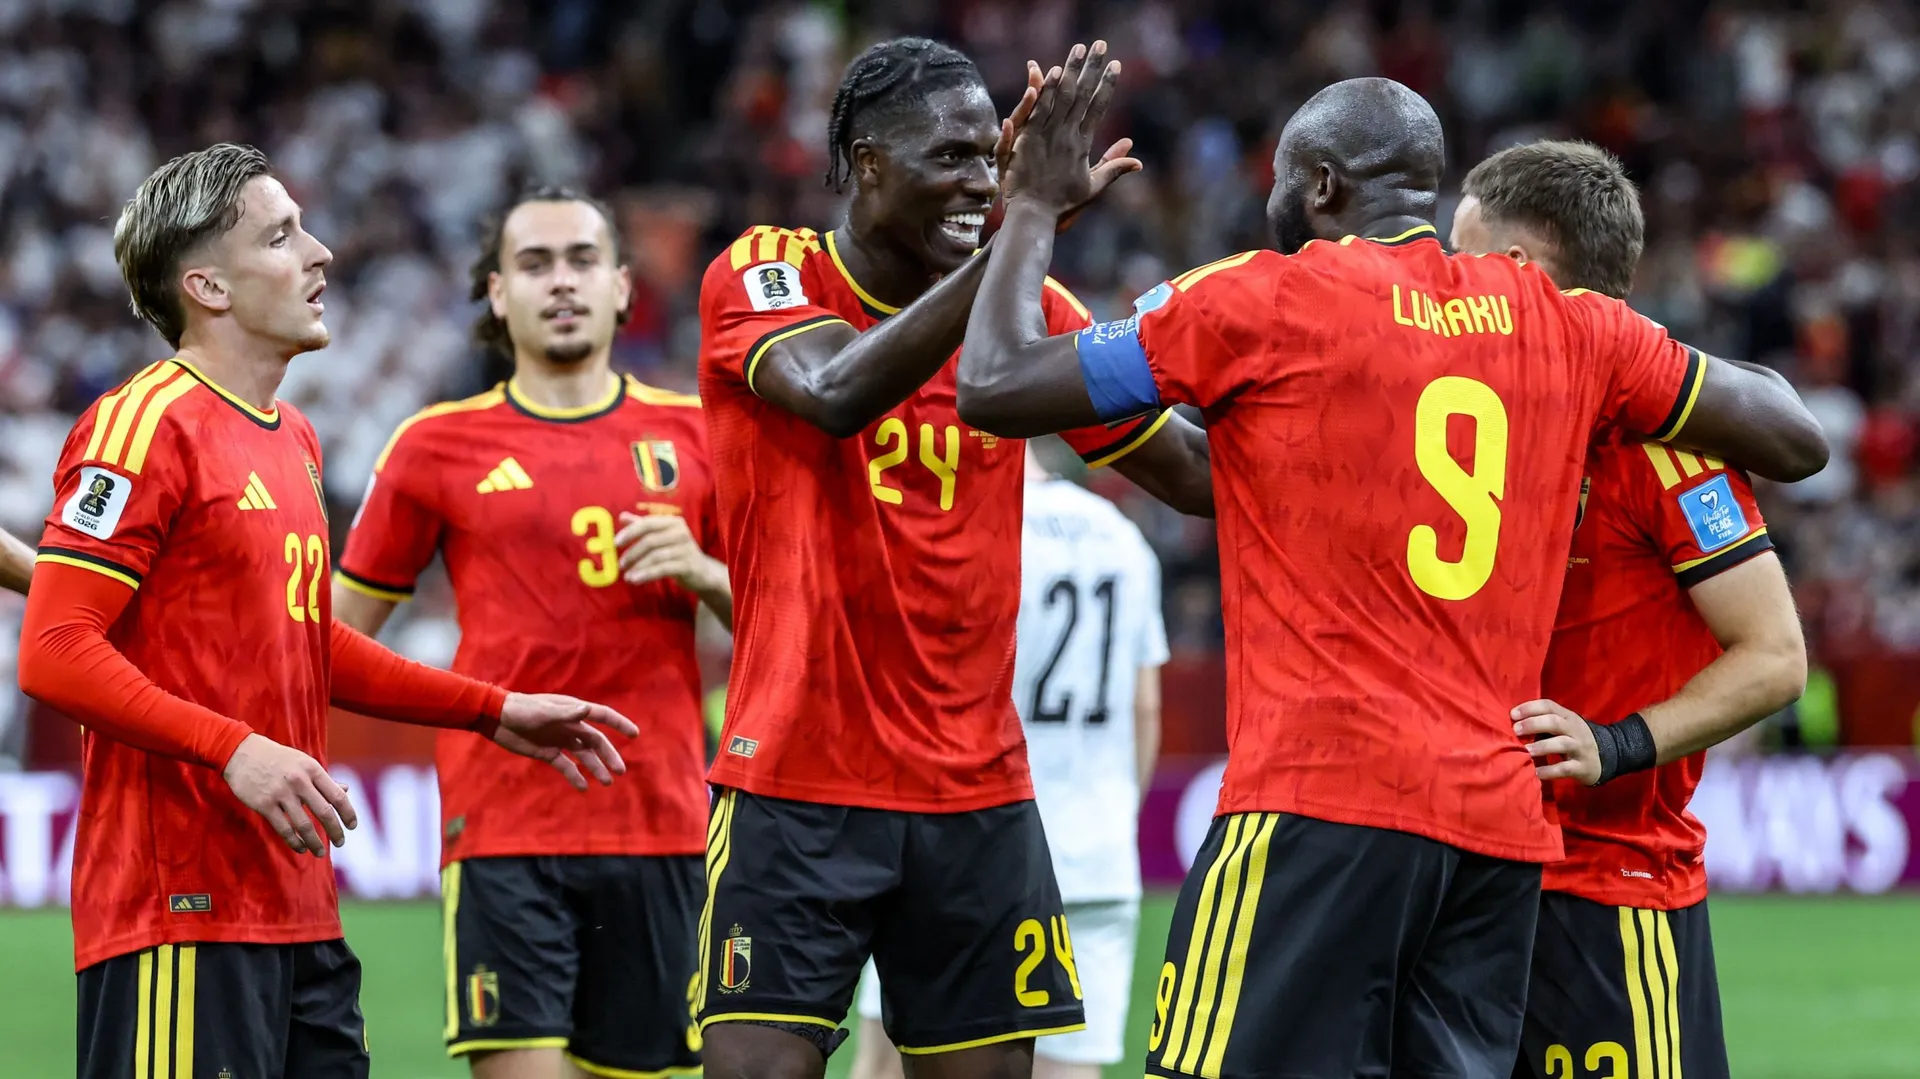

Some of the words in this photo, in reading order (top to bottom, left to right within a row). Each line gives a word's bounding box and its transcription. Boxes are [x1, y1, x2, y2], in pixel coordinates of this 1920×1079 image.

[1392, 284, 1514, 337] LUKAKU
[84, 503, 97, 514] FIFA
[868, 417, 960, 511] 24
[1407, 376, 1509, 600] 9
[73, 516, 98, 531] 2026
[571, 505, 620, 588] 3
[1708, 515, 1734, 535] PEACE
[284, 532, 324, 624] 22
[1028, 574, 1118, 723] 21
[1013, 914, 1083, 1008] 24
[1149, 961, 1177, 1052] 9
